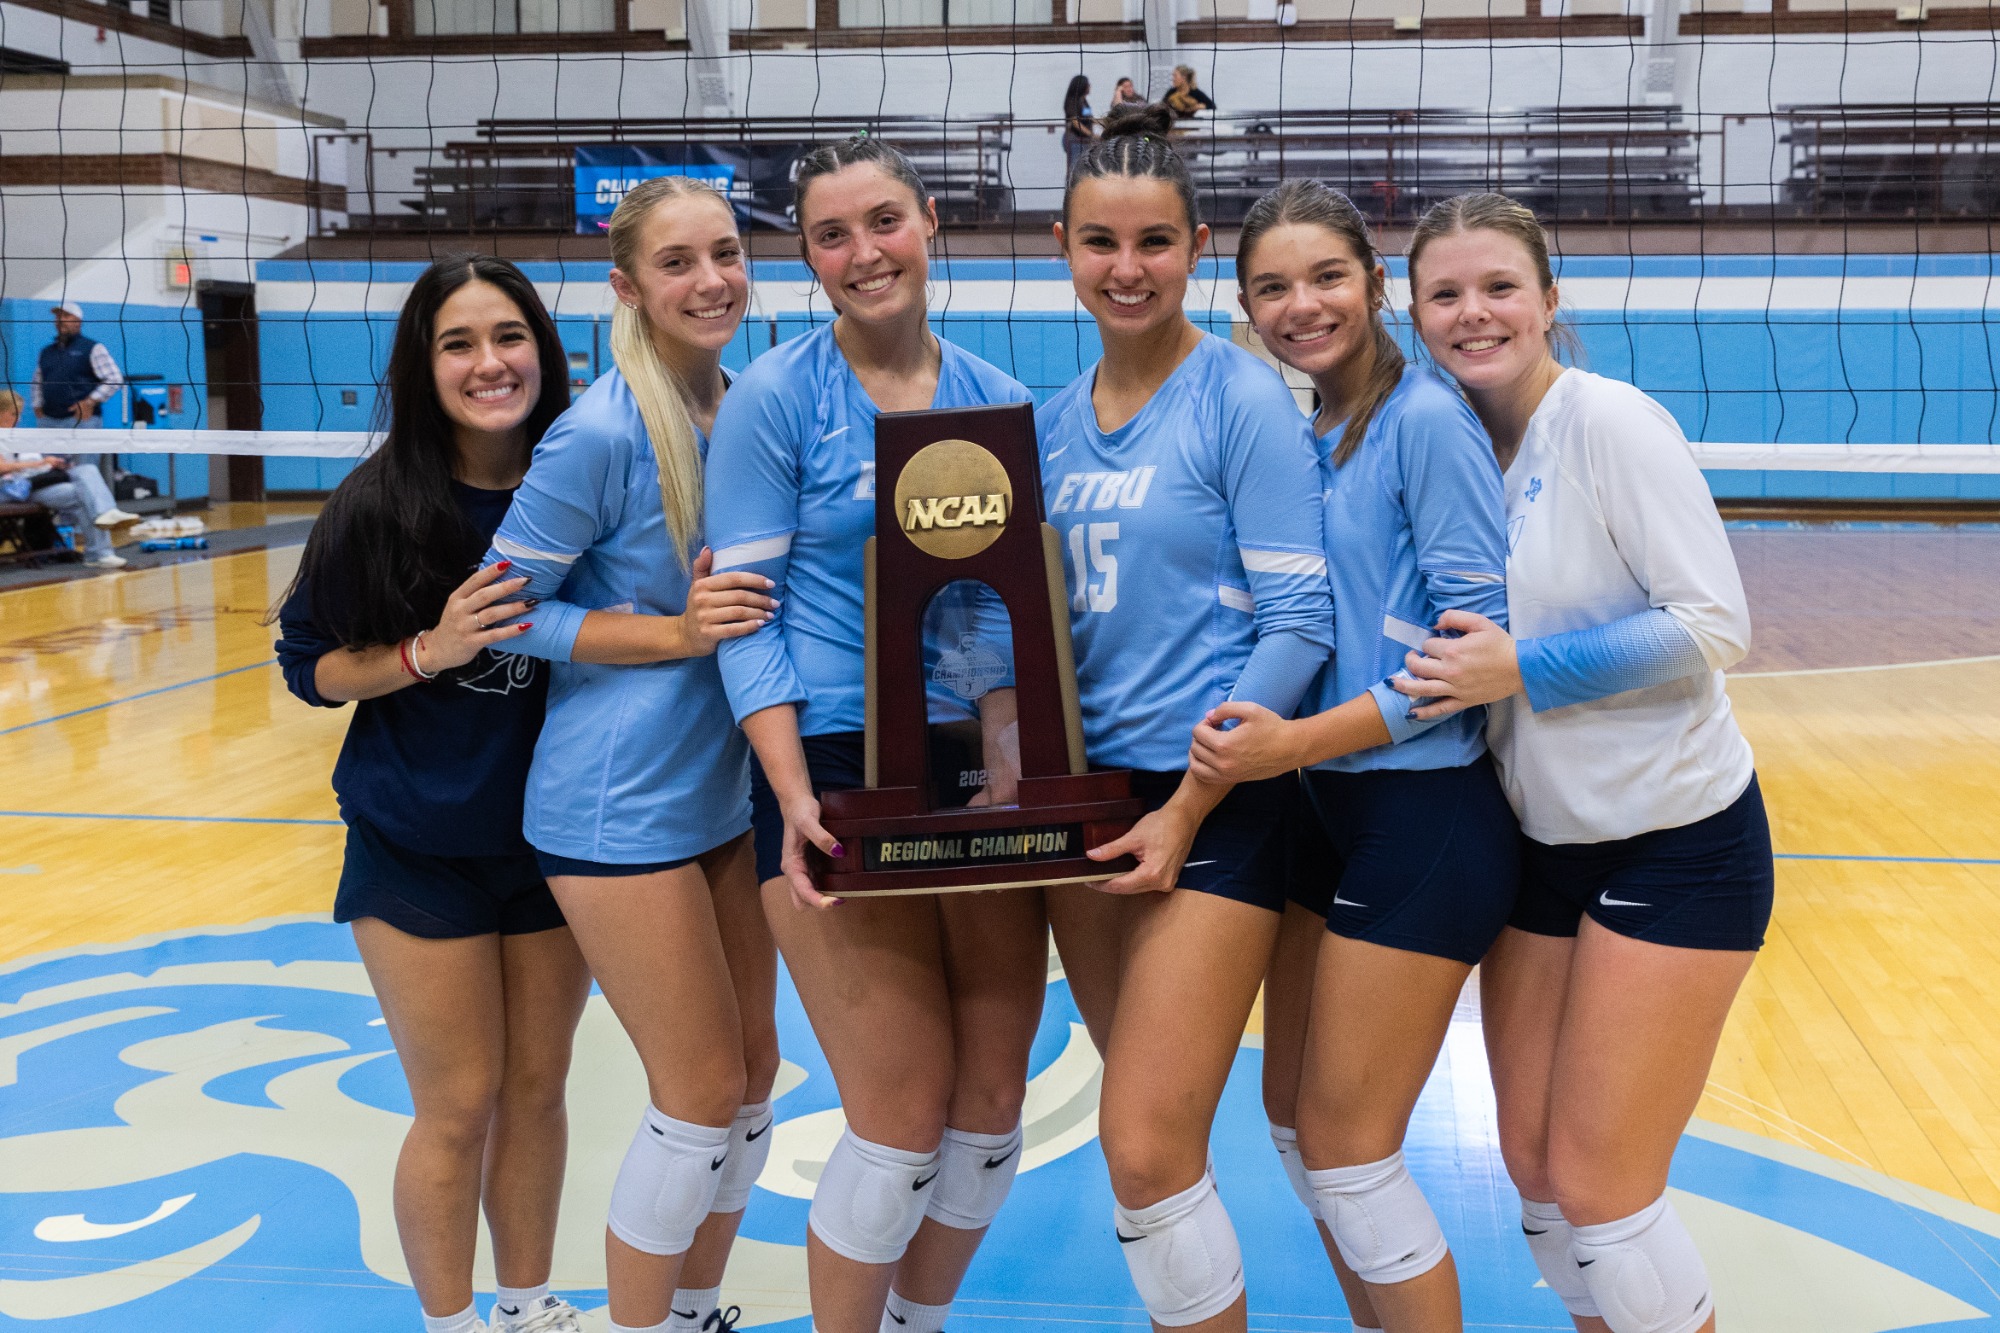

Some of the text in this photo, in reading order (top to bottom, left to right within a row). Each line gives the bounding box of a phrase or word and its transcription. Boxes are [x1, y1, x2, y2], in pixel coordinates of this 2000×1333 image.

[1052, 466, 1157, 515] ETBU
[906, 494, 1006, 531] NCAA
[1069, 522, 1120, 613] 15
[934, 665, 1006, 680] CHAMPIONSHIP
[880, 832, 1068, 862] REGIONAL CHAMPION
